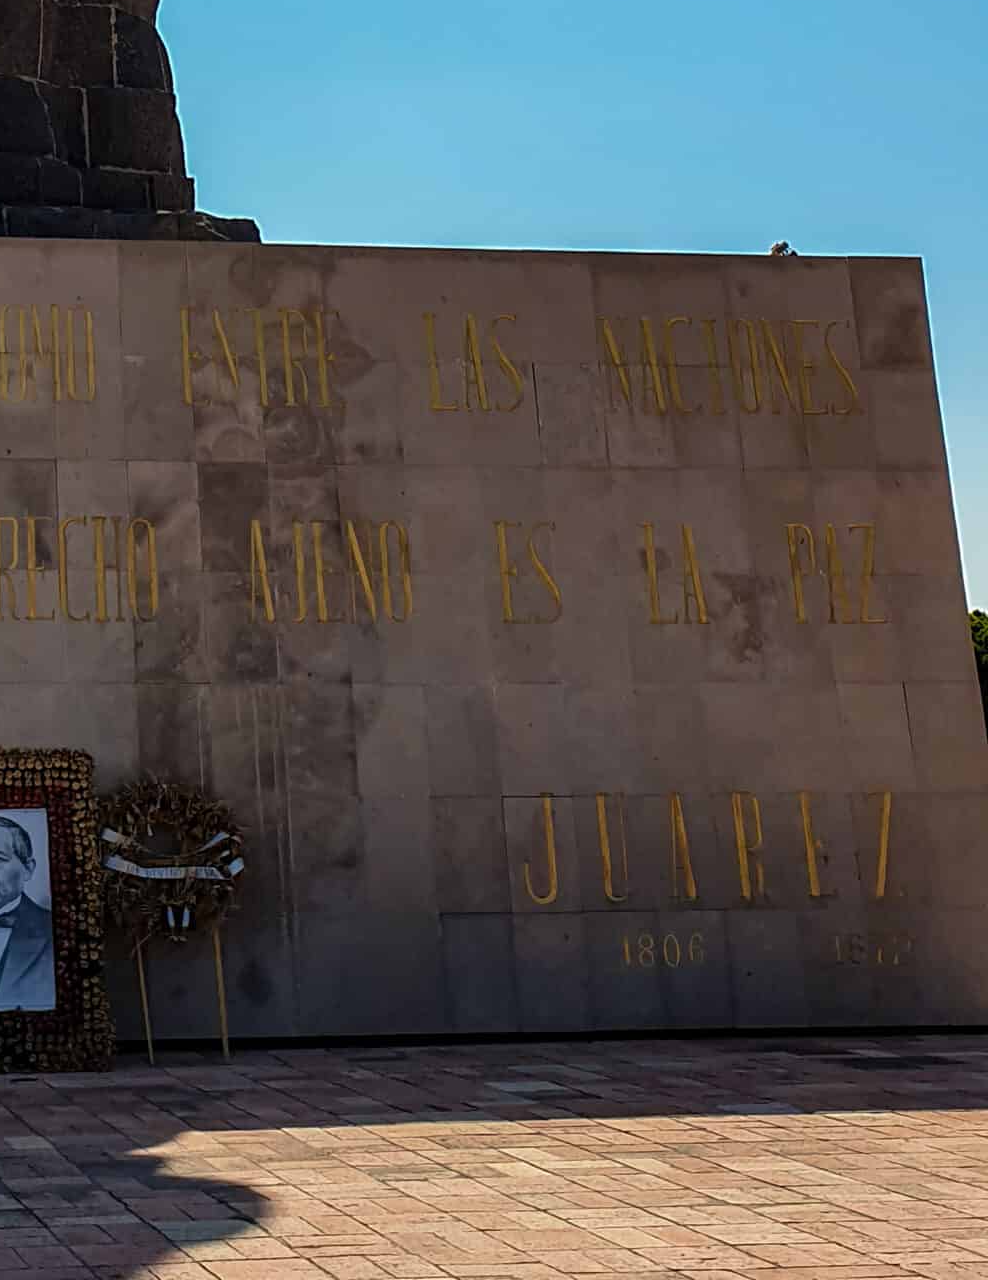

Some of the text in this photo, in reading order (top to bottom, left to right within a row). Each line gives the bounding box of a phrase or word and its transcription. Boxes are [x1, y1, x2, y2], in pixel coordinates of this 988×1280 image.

[179, 304, 345, 408] ENTRE
[422, 312, 525, 412] LAS
[598, 316, 866, 416] NACIONES
[250, 519, 411, 624] AJENO
[494, 521, 562, 624] ES
[638, 521, 711, 625] LA
[784, 523, 888, 625] PAZ
[523, 792, 905, 904] JUAREZ
[622, 932, 708, 968] 1806
